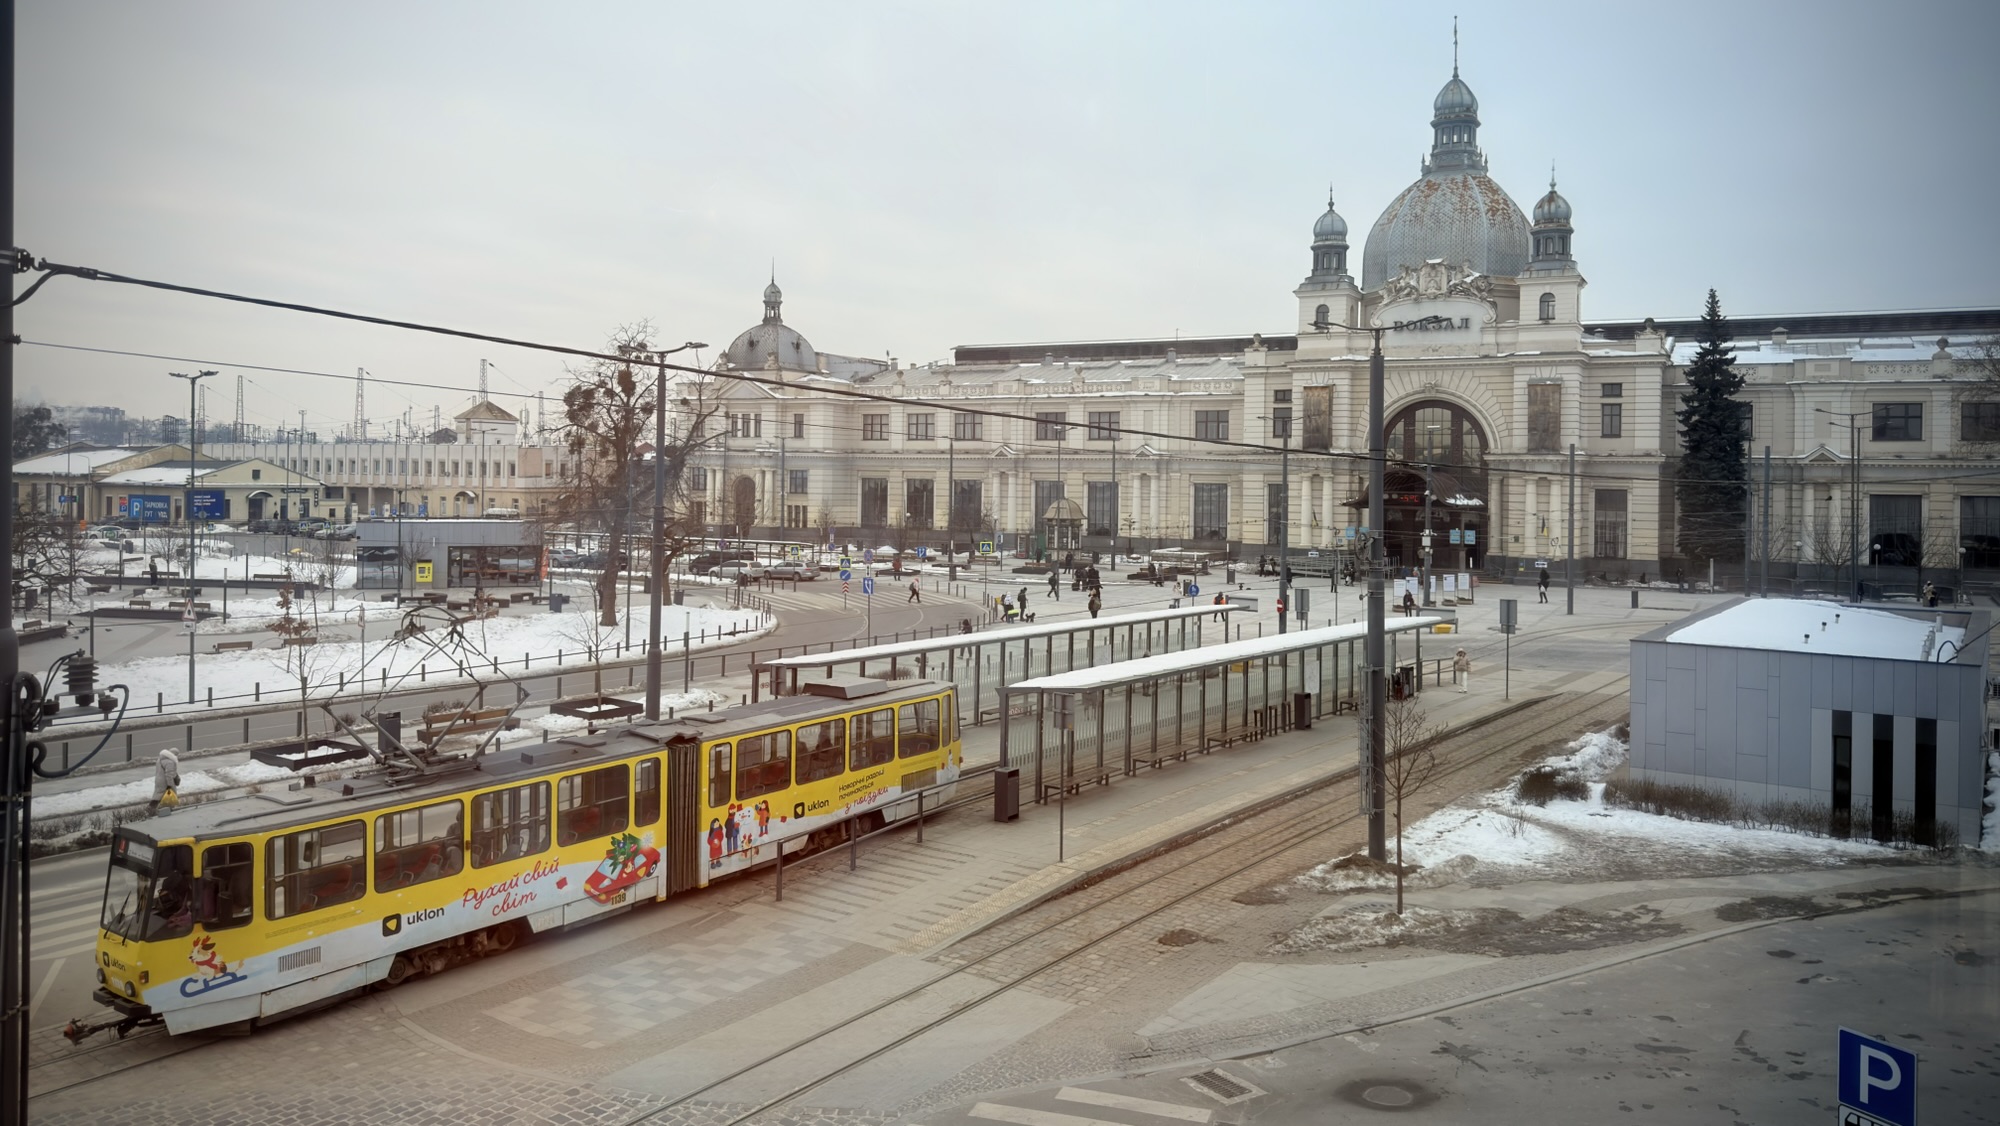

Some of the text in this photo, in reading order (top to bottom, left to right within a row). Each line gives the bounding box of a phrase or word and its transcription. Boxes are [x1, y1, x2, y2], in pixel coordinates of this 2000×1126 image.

[1393, 318, 1470, 332] ВОКЗАЛ
[838, 781, 874, 801] починаються
[853, 786, 889, 807] поїздки
[807, 799, 830, 812] uklon
[462, 857, 559, 910] Рухай свій
[492, 891, 538, 917] світ
[611, 892, 627, 906] 1139
[407, 907, 445, 926] uklon
[110, 956, 127, 972] uklon
[1859, 1044, 1902, 1105] P
